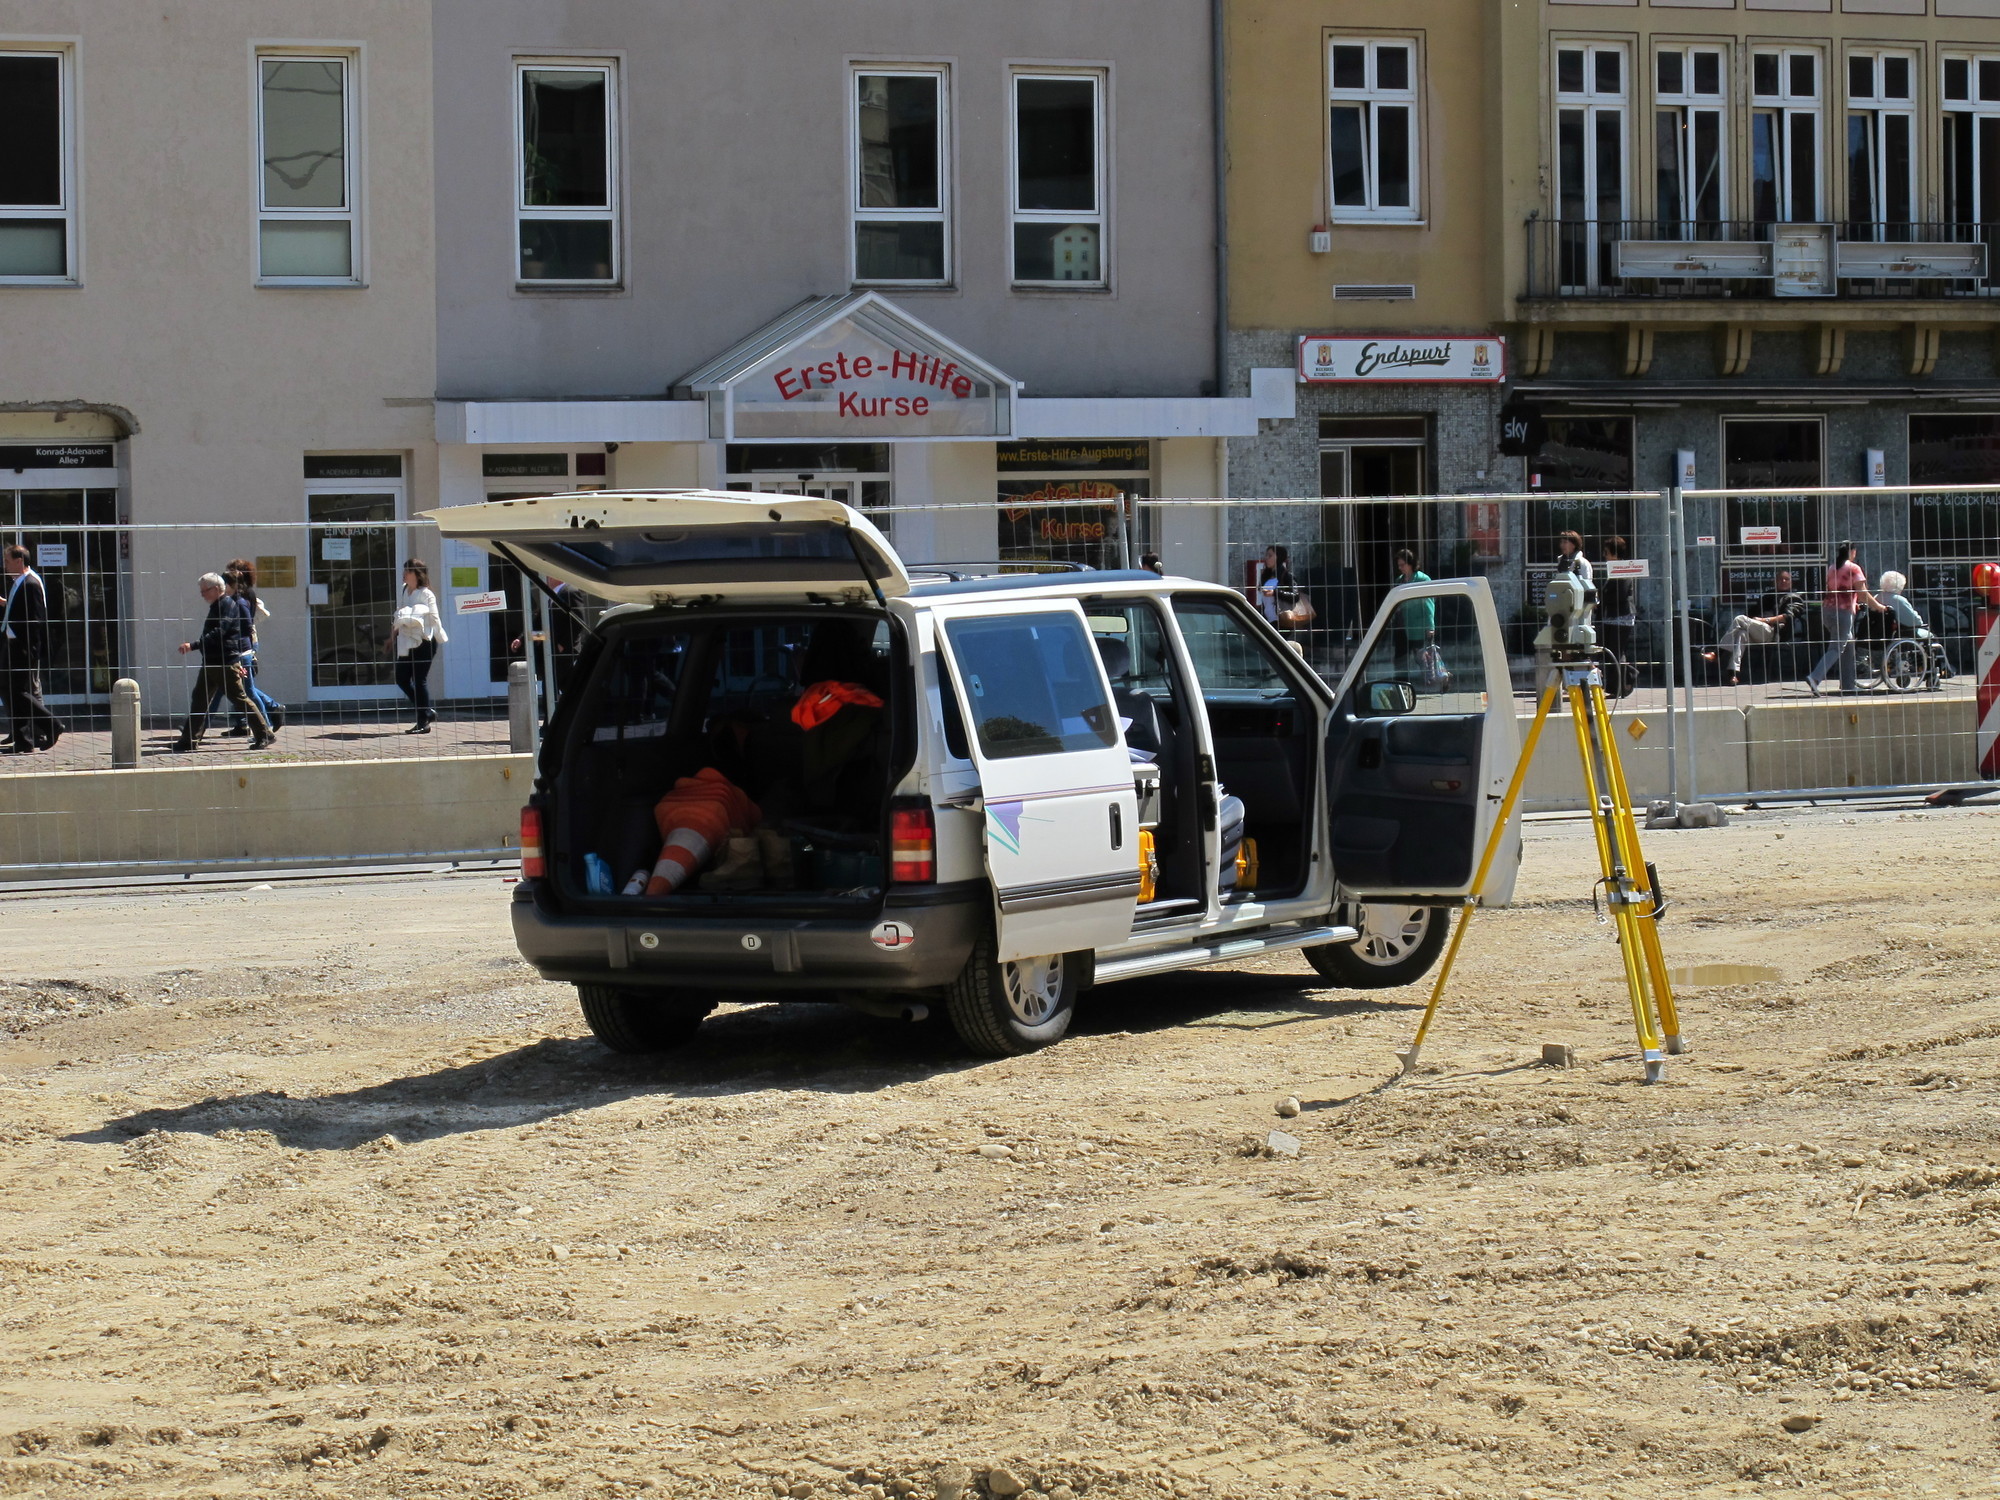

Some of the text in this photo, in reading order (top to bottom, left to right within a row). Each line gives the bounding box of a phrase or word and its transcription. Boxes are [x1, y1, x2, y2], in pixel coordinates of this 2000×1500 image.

[1355, 341, 1451, 377] Endspurt
[774, 350, 972, 400] Erste-Hilfe
[839, 391, 929, 417] Kurse
[1504, 416, 1528, 444] sky
[36, 448, 107, 456] Konrad-Adenauer-
[59, 456, 85, 464] Allee 7
[1546, 500, 1578, 510] TAGES
[1586, 499, 1611, 510] CAFE
[1913, 496, 1942, 506] MUSIC
[324, 527, 379, 536] EINGANG
[1041, 518, 1105, 539] Kurse
[747, 937, 756, 948] D
[884, 924, 900, 947] D
